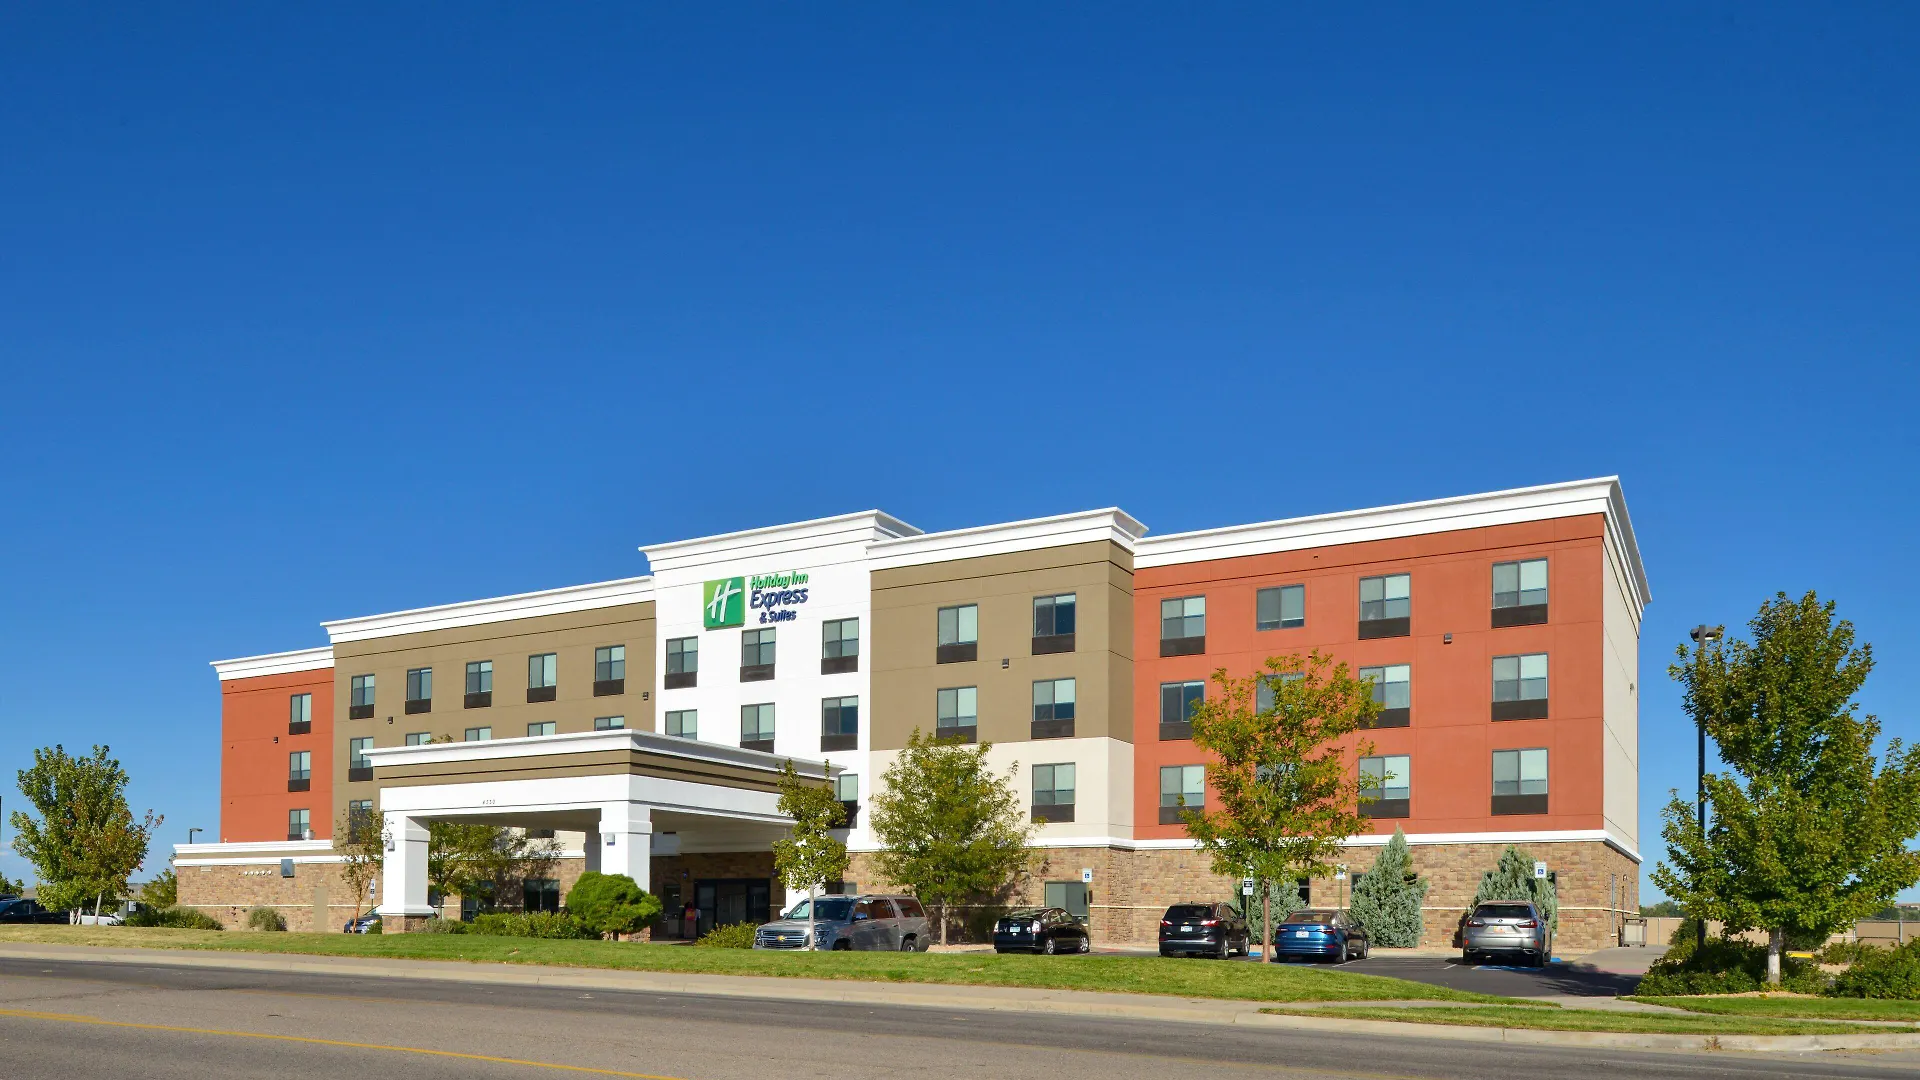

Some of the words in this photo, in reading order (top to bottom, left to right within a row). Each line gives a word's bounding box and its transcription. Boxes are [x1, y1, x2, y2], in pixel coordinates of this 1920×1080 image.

[750, 573, 790, 590] Holiday
[791, 571, 809, 585] Inn
[749, 588, 809, 612] Express
[759, 611, 767, 624] &
[768, 609, 797, 623] Suites
